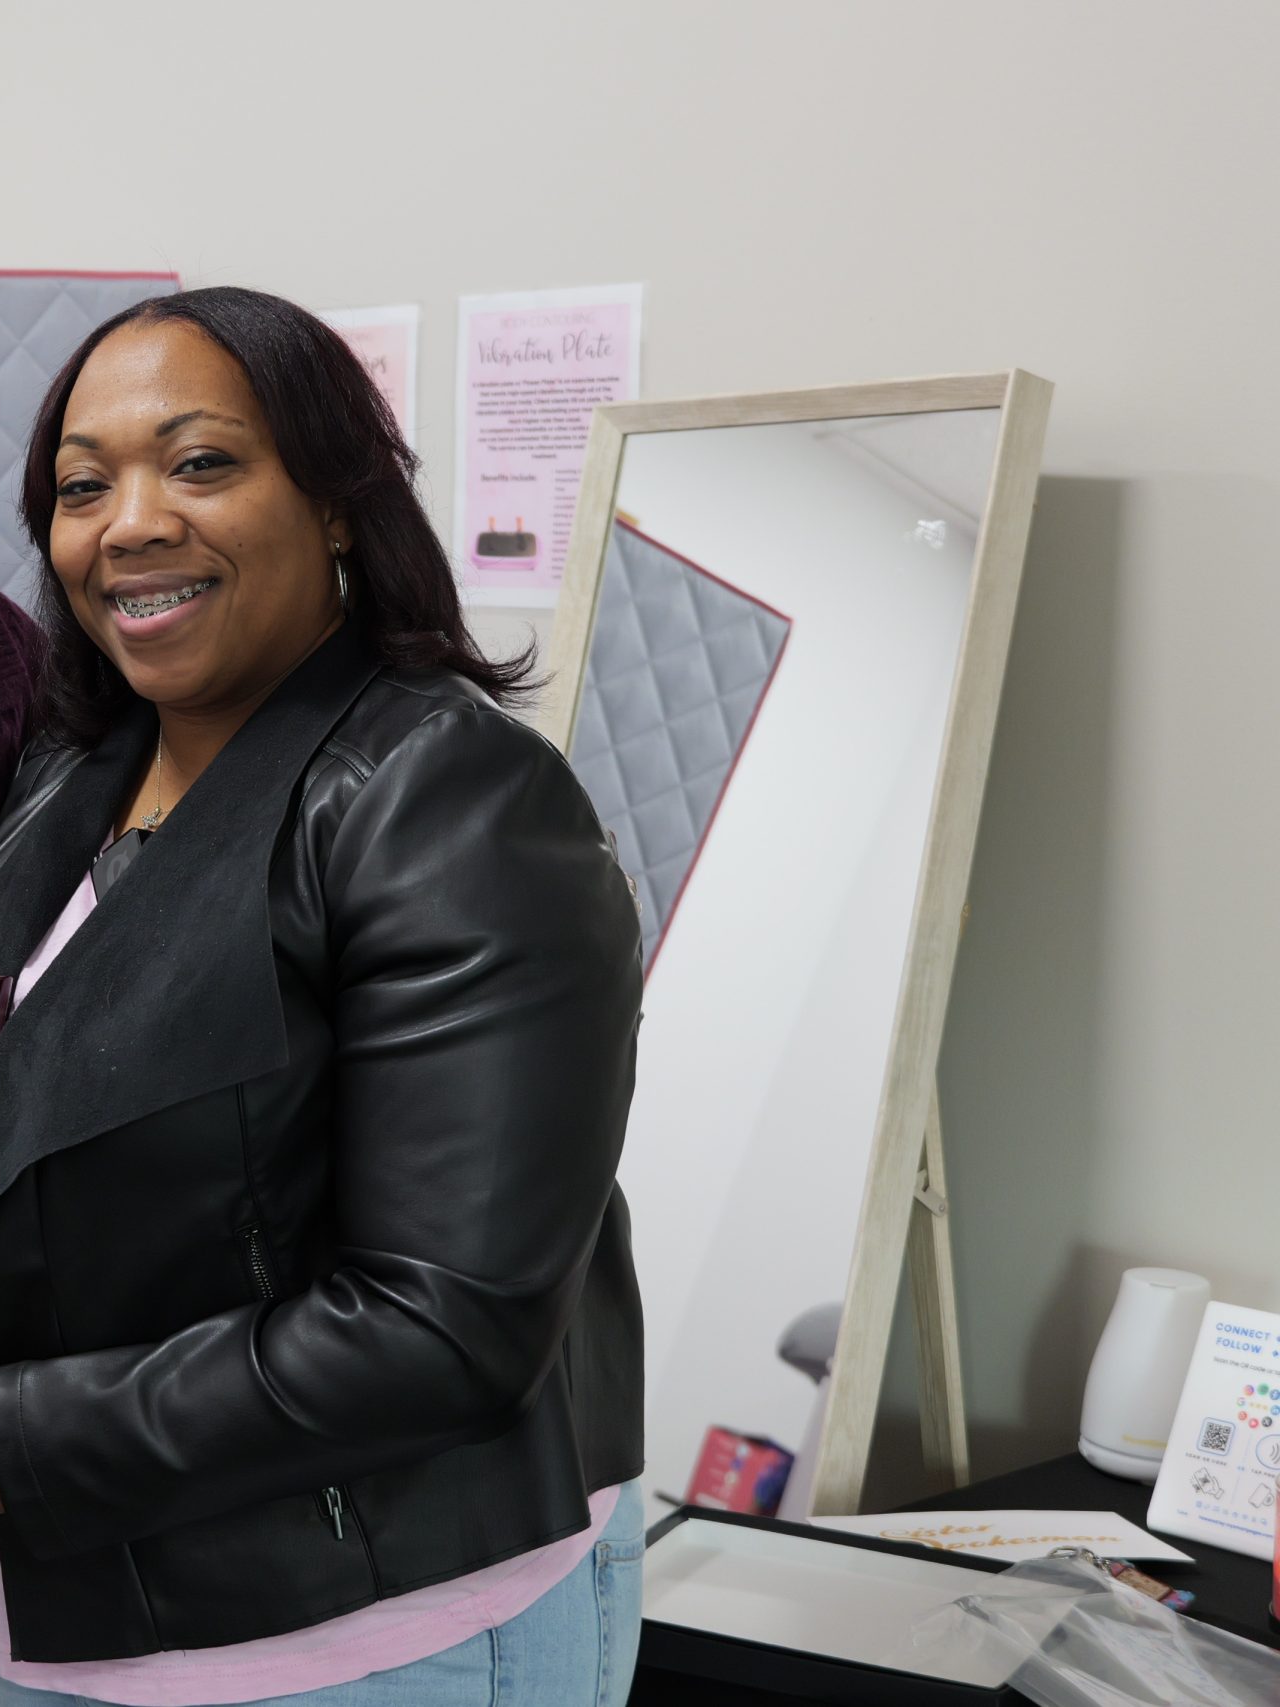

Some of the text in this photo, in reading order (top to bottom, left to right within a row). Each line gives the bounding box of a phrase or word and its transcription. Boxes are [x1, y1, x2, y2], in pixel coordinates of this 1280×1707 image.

[478, 328, 613, 366] Vibration Plate
[1215, 1322, 1271, 1340] CONNECT
[1215, 1337, 1262, 1354] FOLLOW
[1250, 1364, 1266, 1373] code
